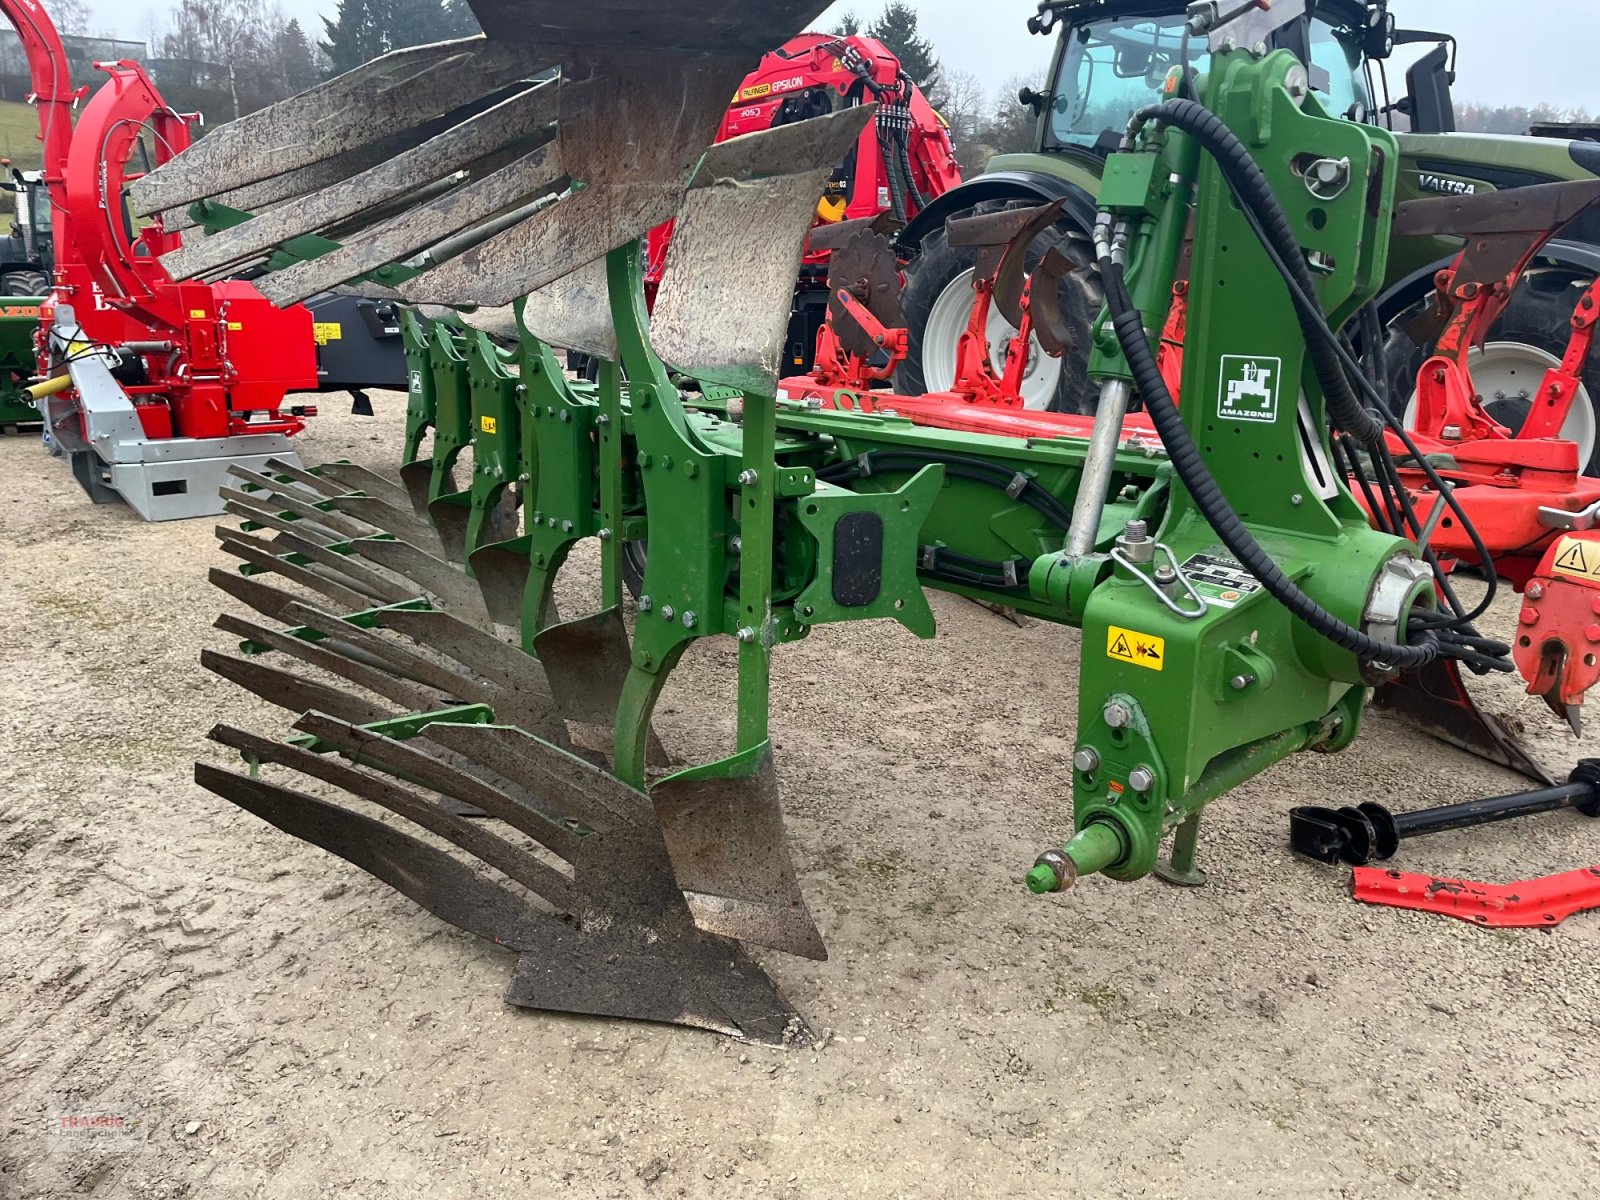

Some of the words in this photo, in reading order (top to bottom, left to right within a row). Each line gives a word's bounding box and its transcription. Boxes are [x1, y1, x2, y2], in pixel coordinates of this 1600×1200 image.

[743, 85, 769, 97] PALFINGER
[772, 76, 803, 92] EPSILON
[1419, 174, 1475, 195] VALTRA
[1220, 408, 1274, 419] AMAZONE
